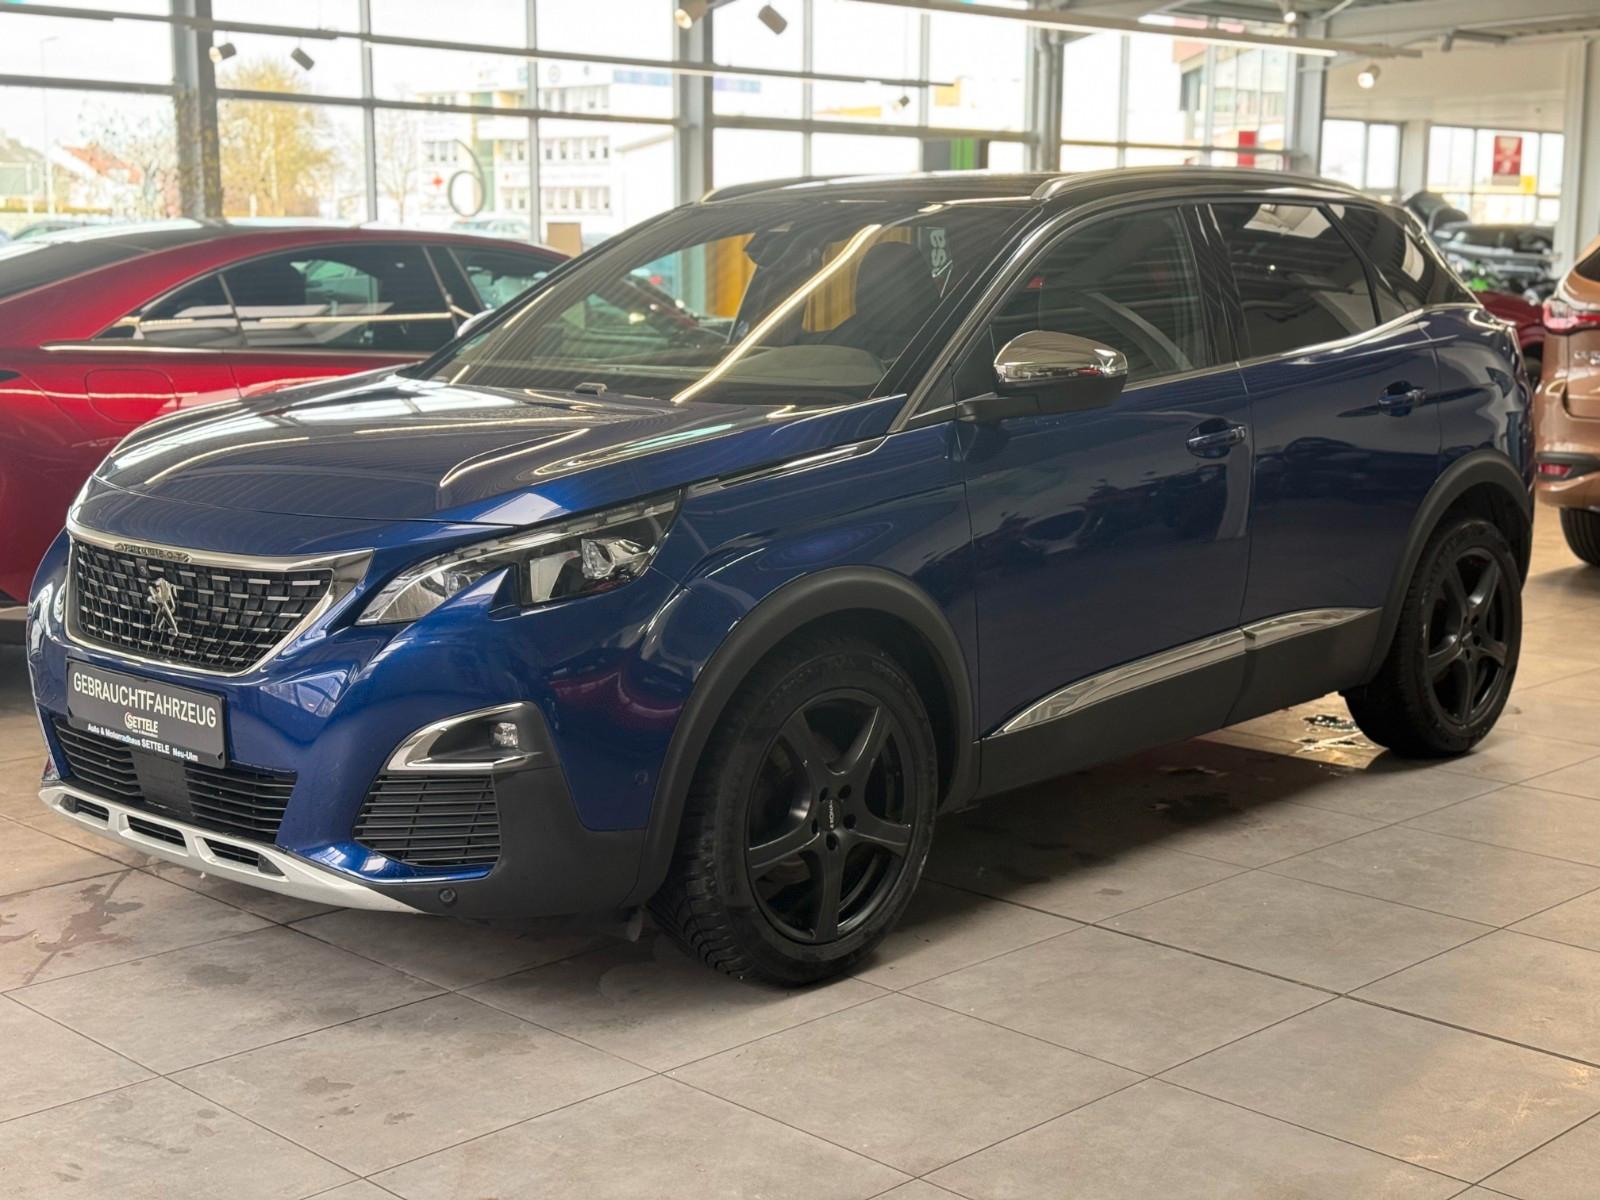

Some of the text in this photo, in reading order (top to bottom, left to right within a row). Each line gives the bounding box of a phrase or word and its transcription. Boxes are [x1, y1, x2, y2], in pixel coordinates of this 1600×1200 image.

[73, 672, 217, 728] GEBRAUCHTFAHRZEUG
[125, 713, 159, 733] SETTELE
[141, 738, 170, 755] SETTELE
[172, 747, 199, 762] Neu-Ulm
